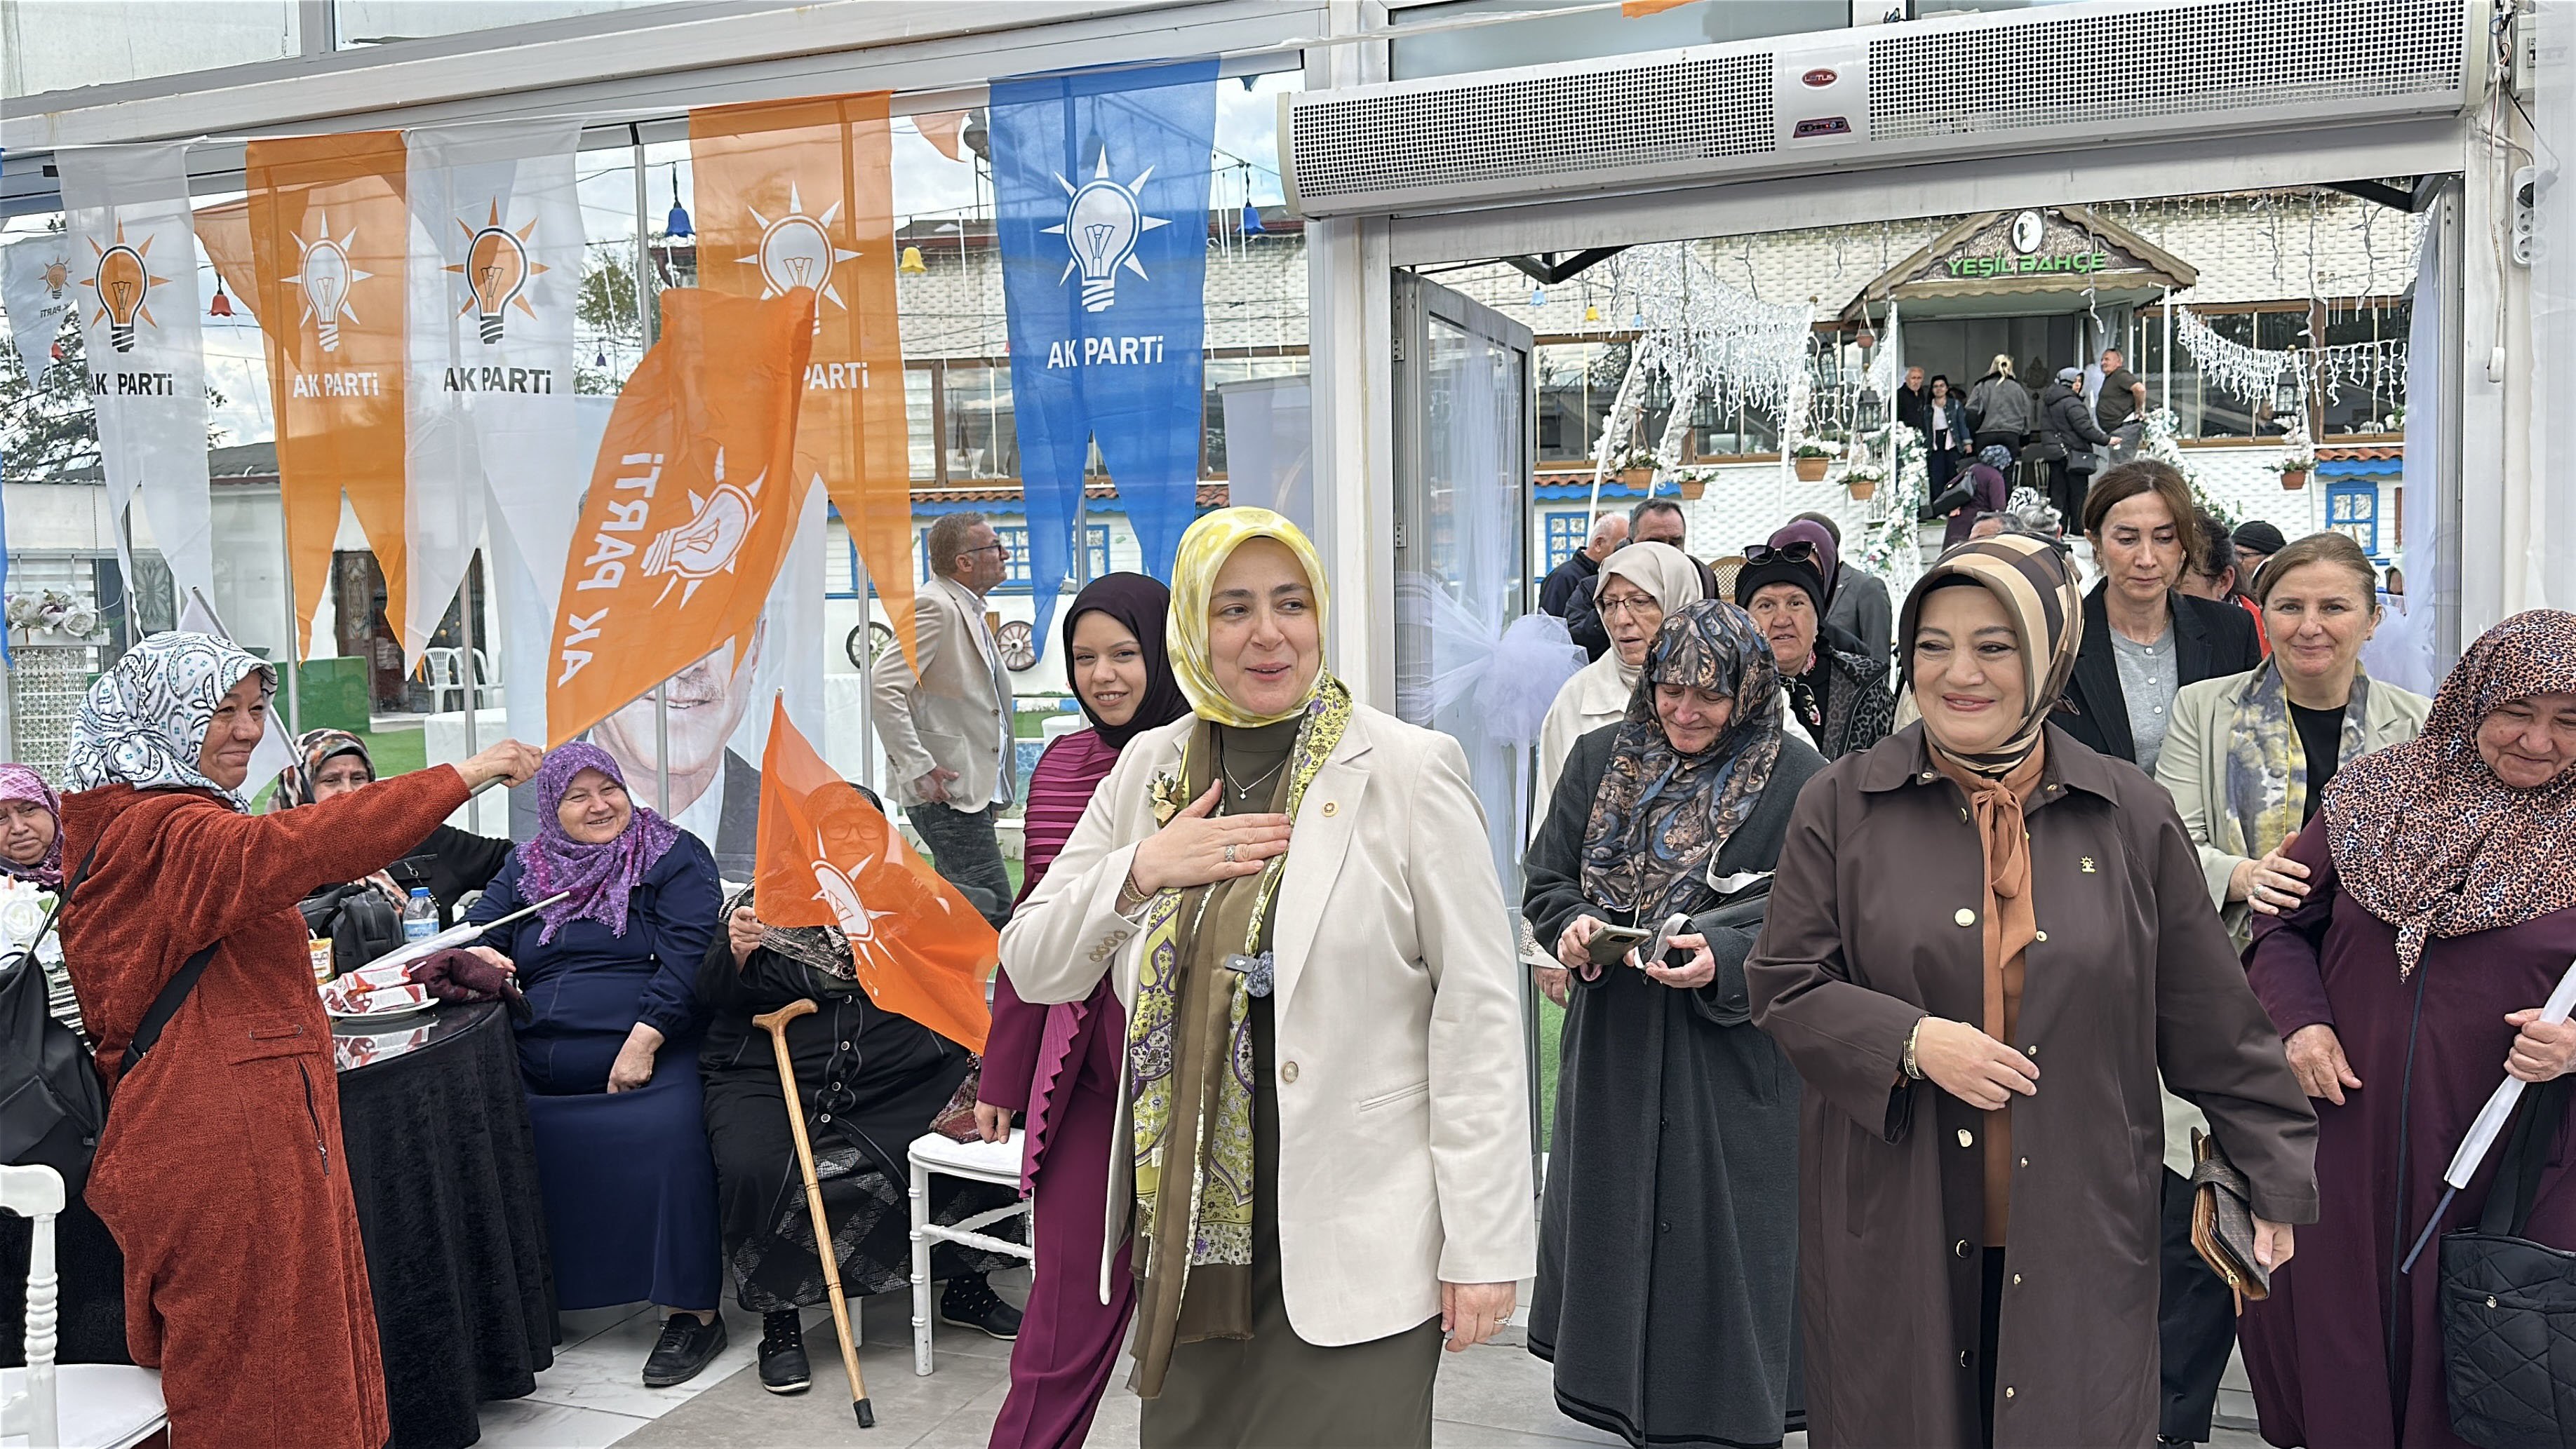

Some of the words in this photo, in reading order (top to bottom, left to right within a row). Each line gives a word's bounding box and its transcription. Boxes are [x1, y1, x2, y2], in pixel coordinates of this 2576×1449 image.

[1947, 250, 2014, 278] YEŞİL
[2019, 252, 2107, 274] BAHÇE
[1047, 339, 1078, 369] AK
[293, 374, 321, 398] AK
[443, 368, 477, 391] AK
